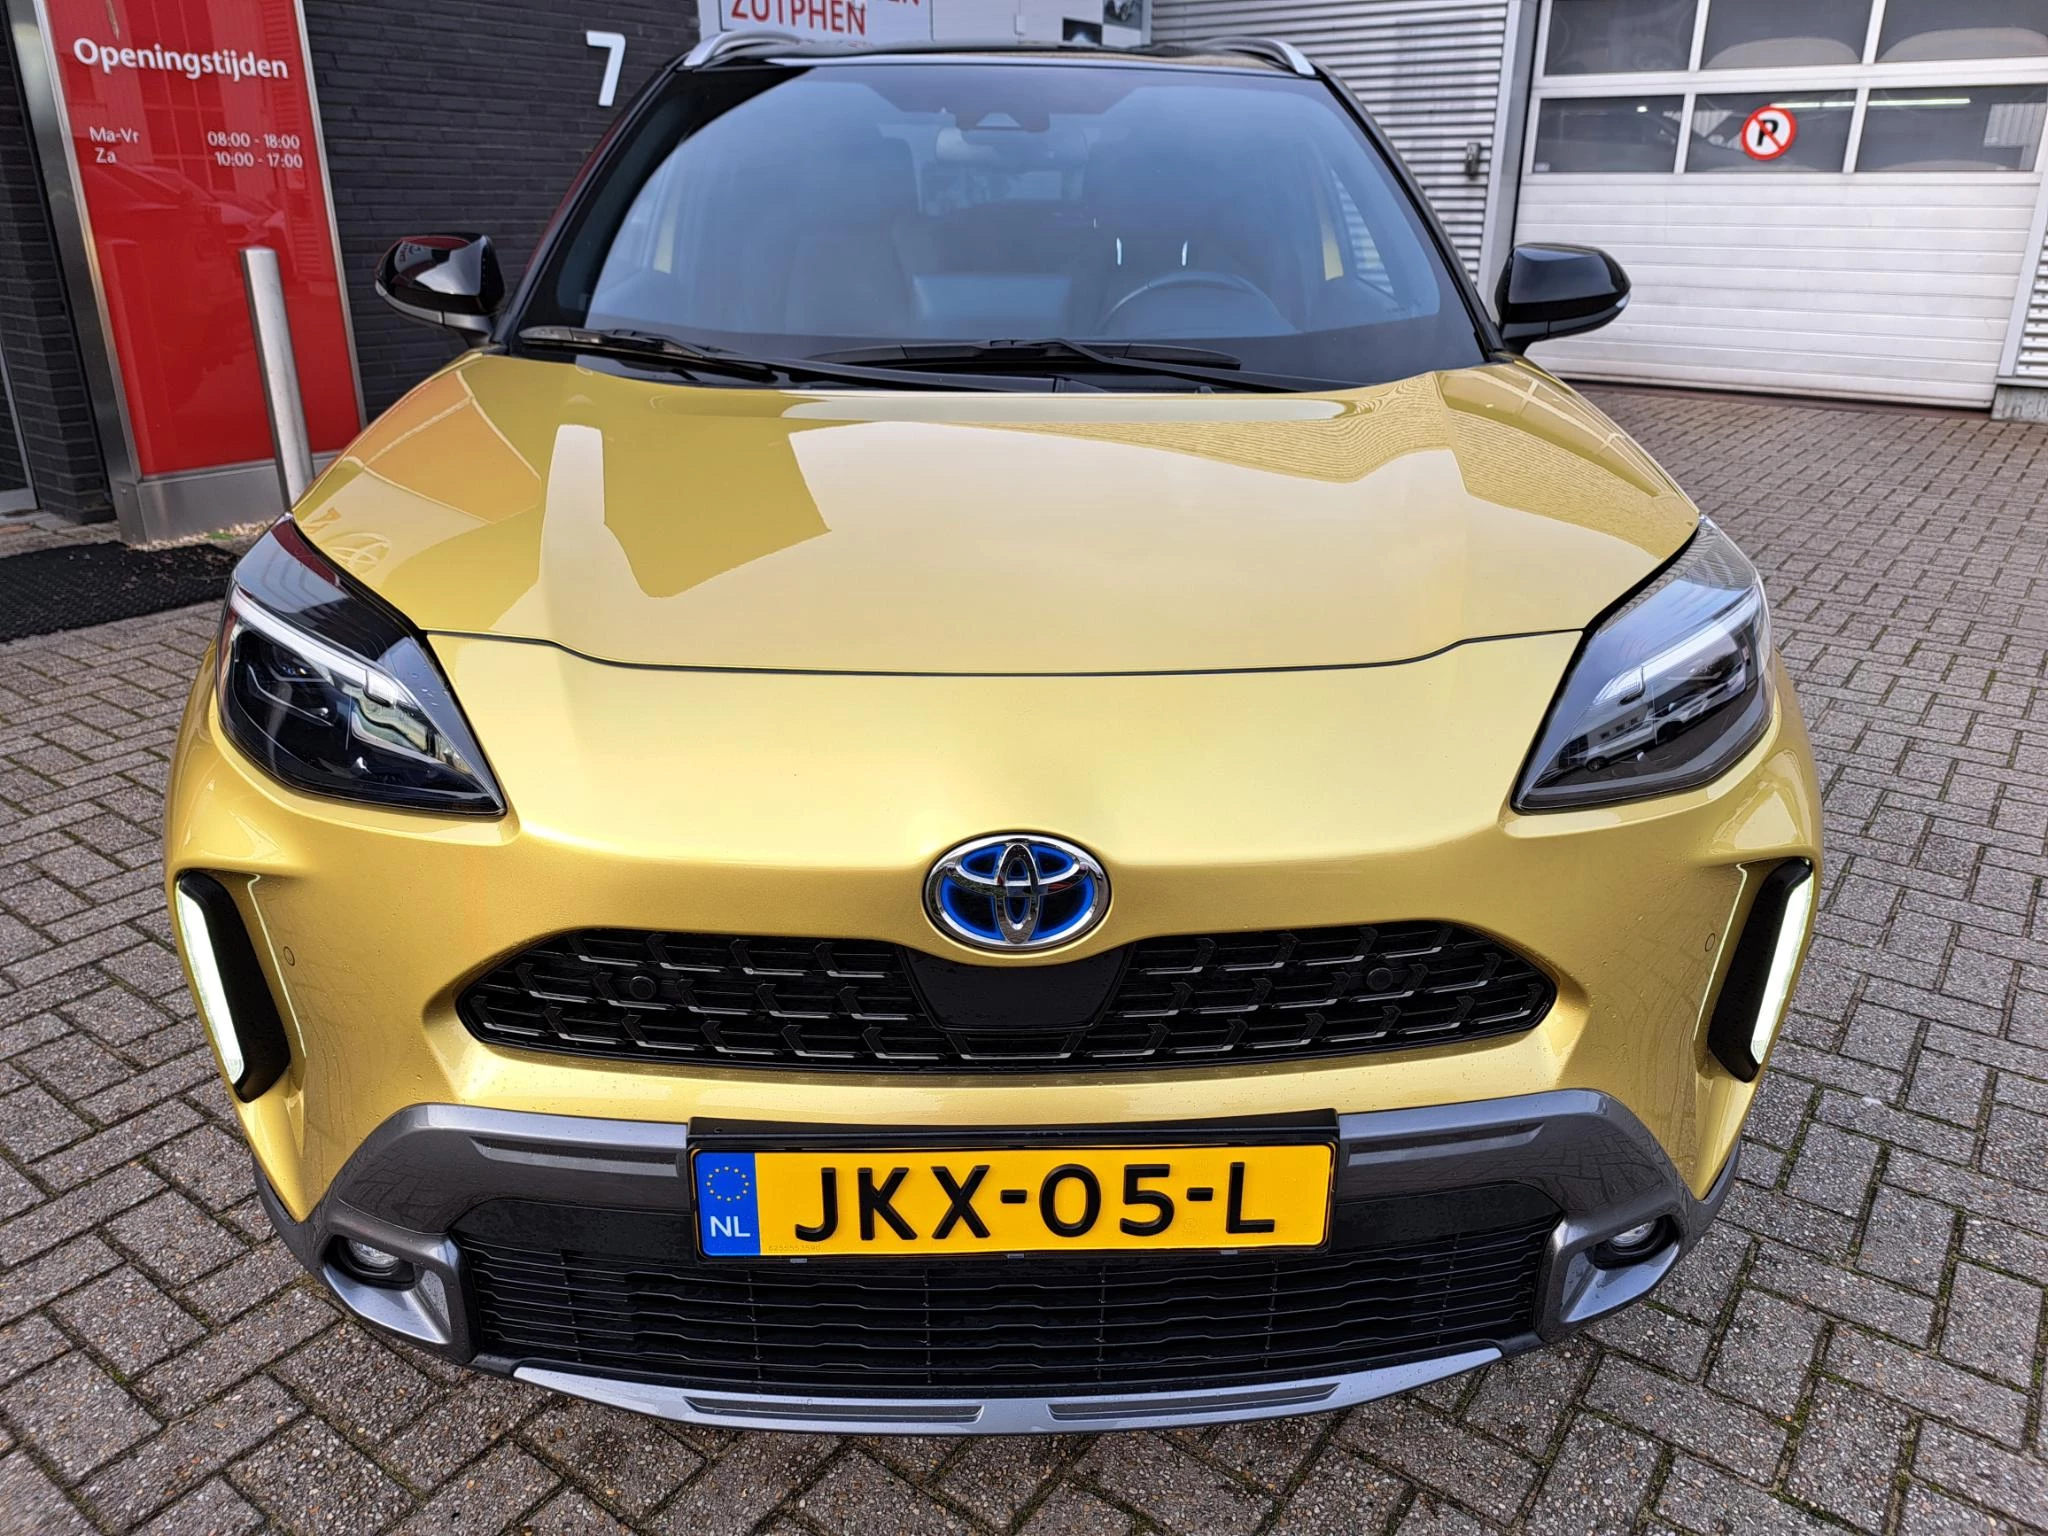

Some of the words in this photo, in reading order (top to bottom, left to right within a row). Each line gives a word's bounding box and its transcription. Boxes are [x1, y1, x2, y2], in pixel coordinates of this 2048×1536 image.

[731, 0, 866, 36] ZUTPHEN
[74, 37, 289, 82] Openingstijden
[585, 31, 626, 107] 7
[89, 126, 140, 144] Ma-Vr
[207, 131, 251, 148] 08:00
[263, 133, 300, 149] 18:00
[1756, 119, 1779, 147] P
[95, 147, 117, 164] Za
[214, 151, 254, 167] 10:00
[266, 152, 303, 168] 17:00
[794, 1161, 1275, 1242] JKX-05-L
[710, 1215, 751, 1238] NL
